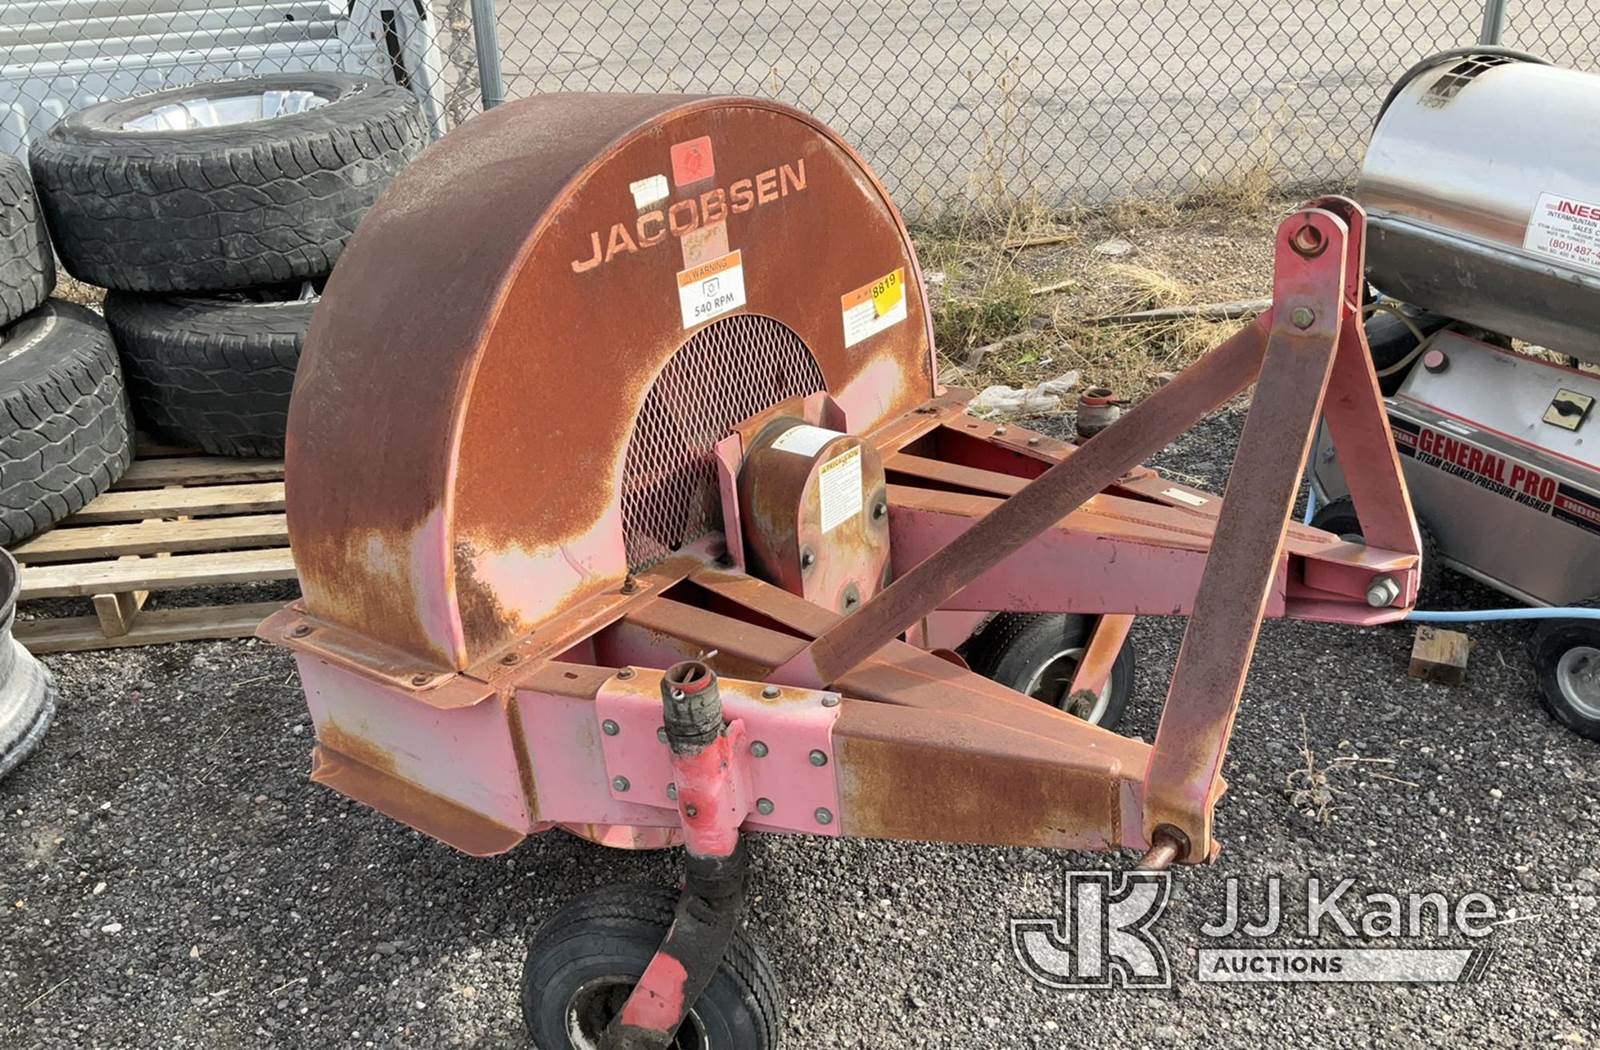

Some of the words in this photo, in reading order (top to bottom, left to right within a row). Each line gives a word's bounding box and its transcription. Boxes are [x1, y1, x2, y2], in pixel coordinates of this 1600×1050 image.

[571, 158, 807, 273] JACOBSEN
[1546, 211, 1597, 228] INTERMOUNTAIN
[1572, 224, 1593, 234] SALES
[1549, 238, 1573, 252] (801)
[692, 258, 728, 279] WARNING
[872, 273, 896, 298] 8819
[694, 301, 712, 317] 540
[714, 292, 735, 309] RPM
[1419, 429, 1505, 483] GENERAL
[1509, 464, 1556, 502] PRO
[1416, 452, 1443, 468] STEAM
[1442, 461, 1516, 499] CLEANER/PRESSURE
[1516, 491, 1552, 514] WASHER
